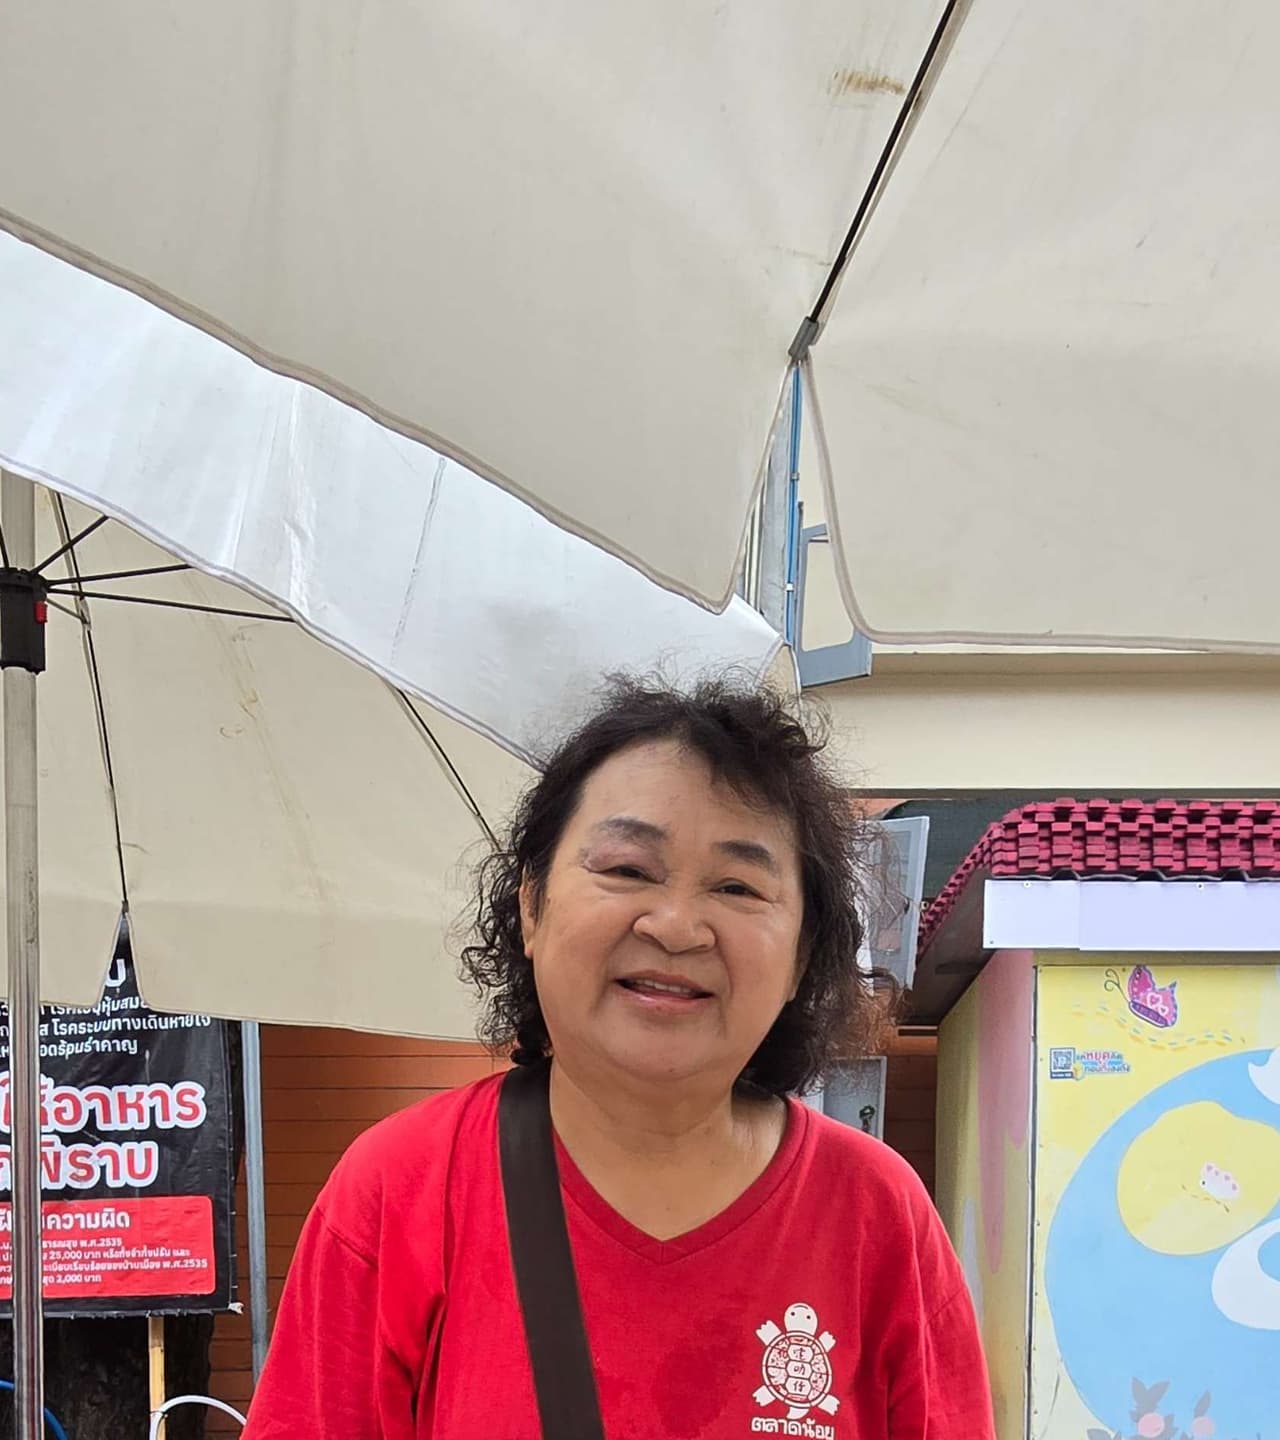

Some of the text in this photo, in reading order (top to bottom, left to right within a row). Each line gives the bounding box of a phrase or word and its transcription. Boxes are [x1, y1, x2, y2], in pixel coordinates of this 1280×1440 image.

[49, 1250, 81, 1261] 25,000
[84, 1250, 101, 1260] บาท
[56, 1273, 82, 1284] 2,000
